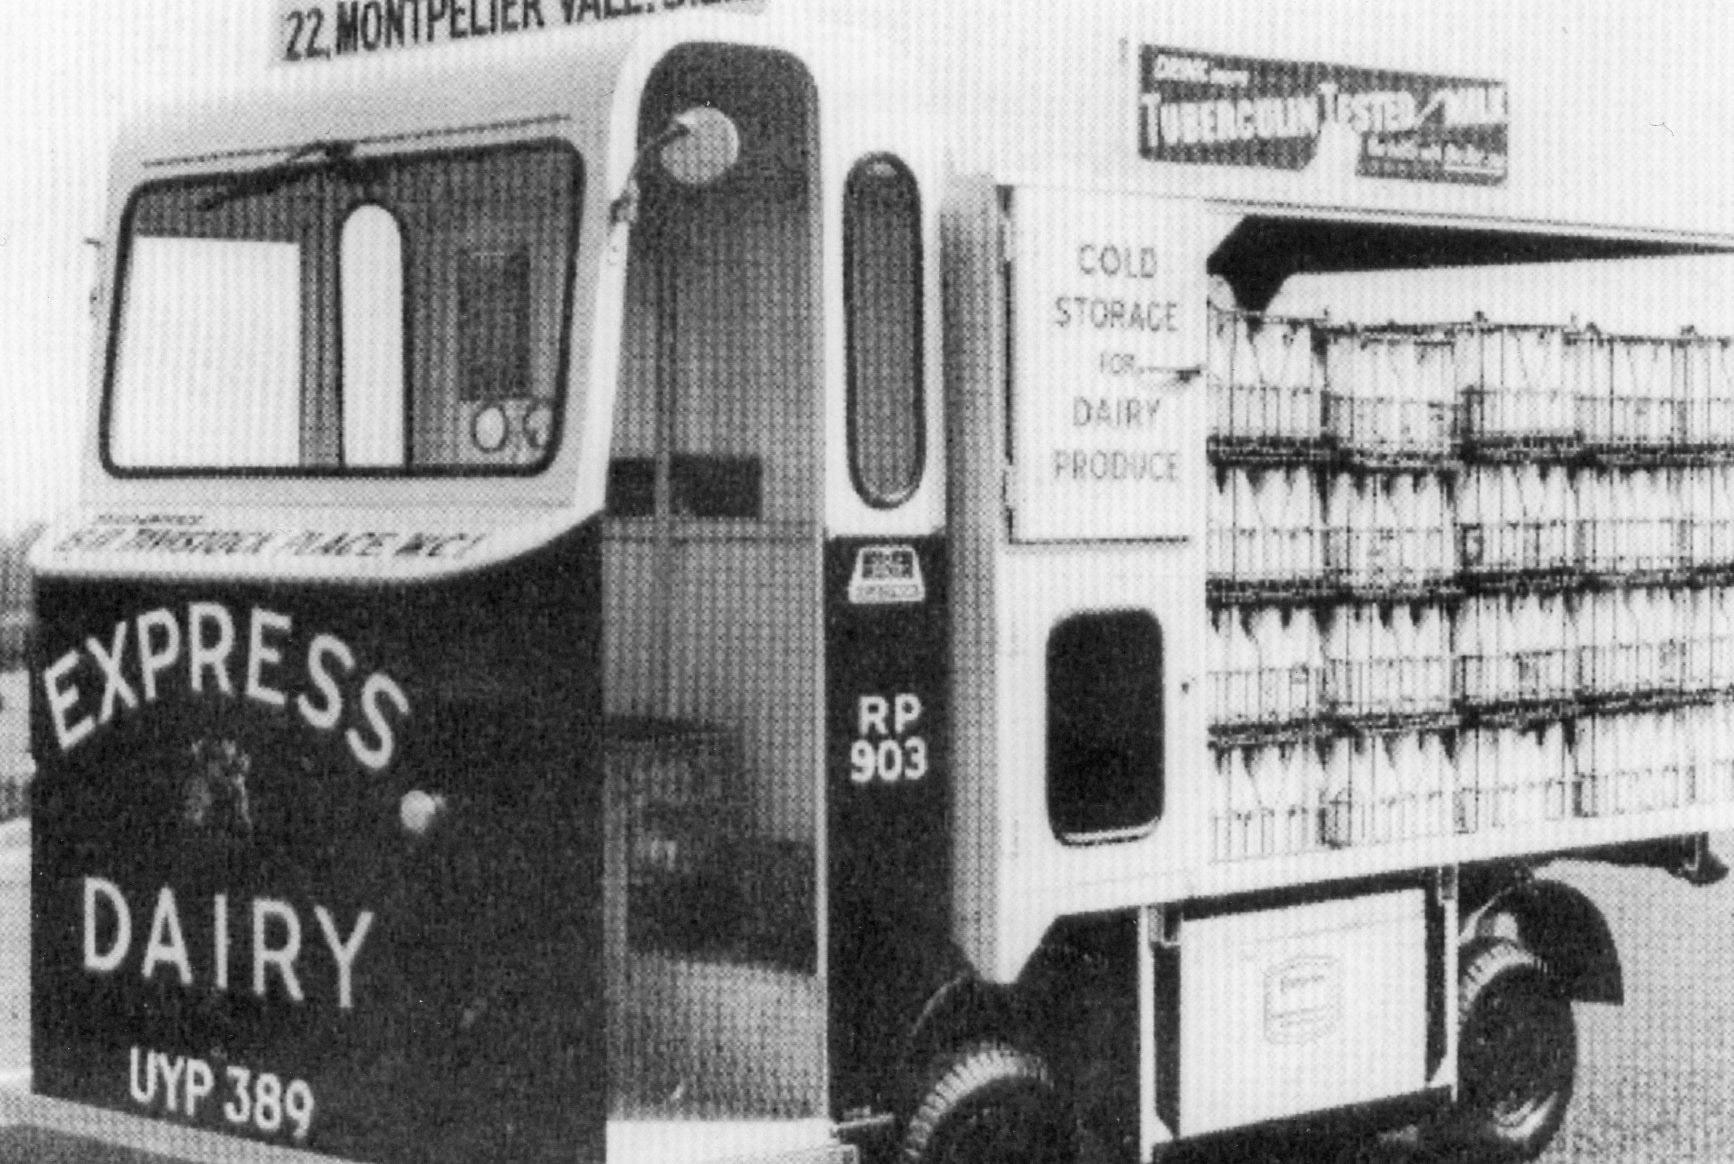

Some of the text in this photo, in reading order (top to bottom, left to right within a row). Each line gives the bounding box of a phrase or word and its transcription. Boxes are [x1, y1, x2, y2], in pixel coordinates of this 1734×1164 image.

[336, 0, 545, 55] MONTPELIER
[1078, 244, 1158, 279] COLD
[1054, 296, 1179, 332] STORAGE
[1072, 397, 1161, 427] DAIRY
[1054, 449, 1179, 482] PRODUCE
[43, 601, 410, 770] EXPRESS
[857, 693, 922, 735] RP
[850, 736, 929, 783] 903
[83, 875, 374, 1008] DAIRY
[130, 1046, 315, 1139] UYP 389
